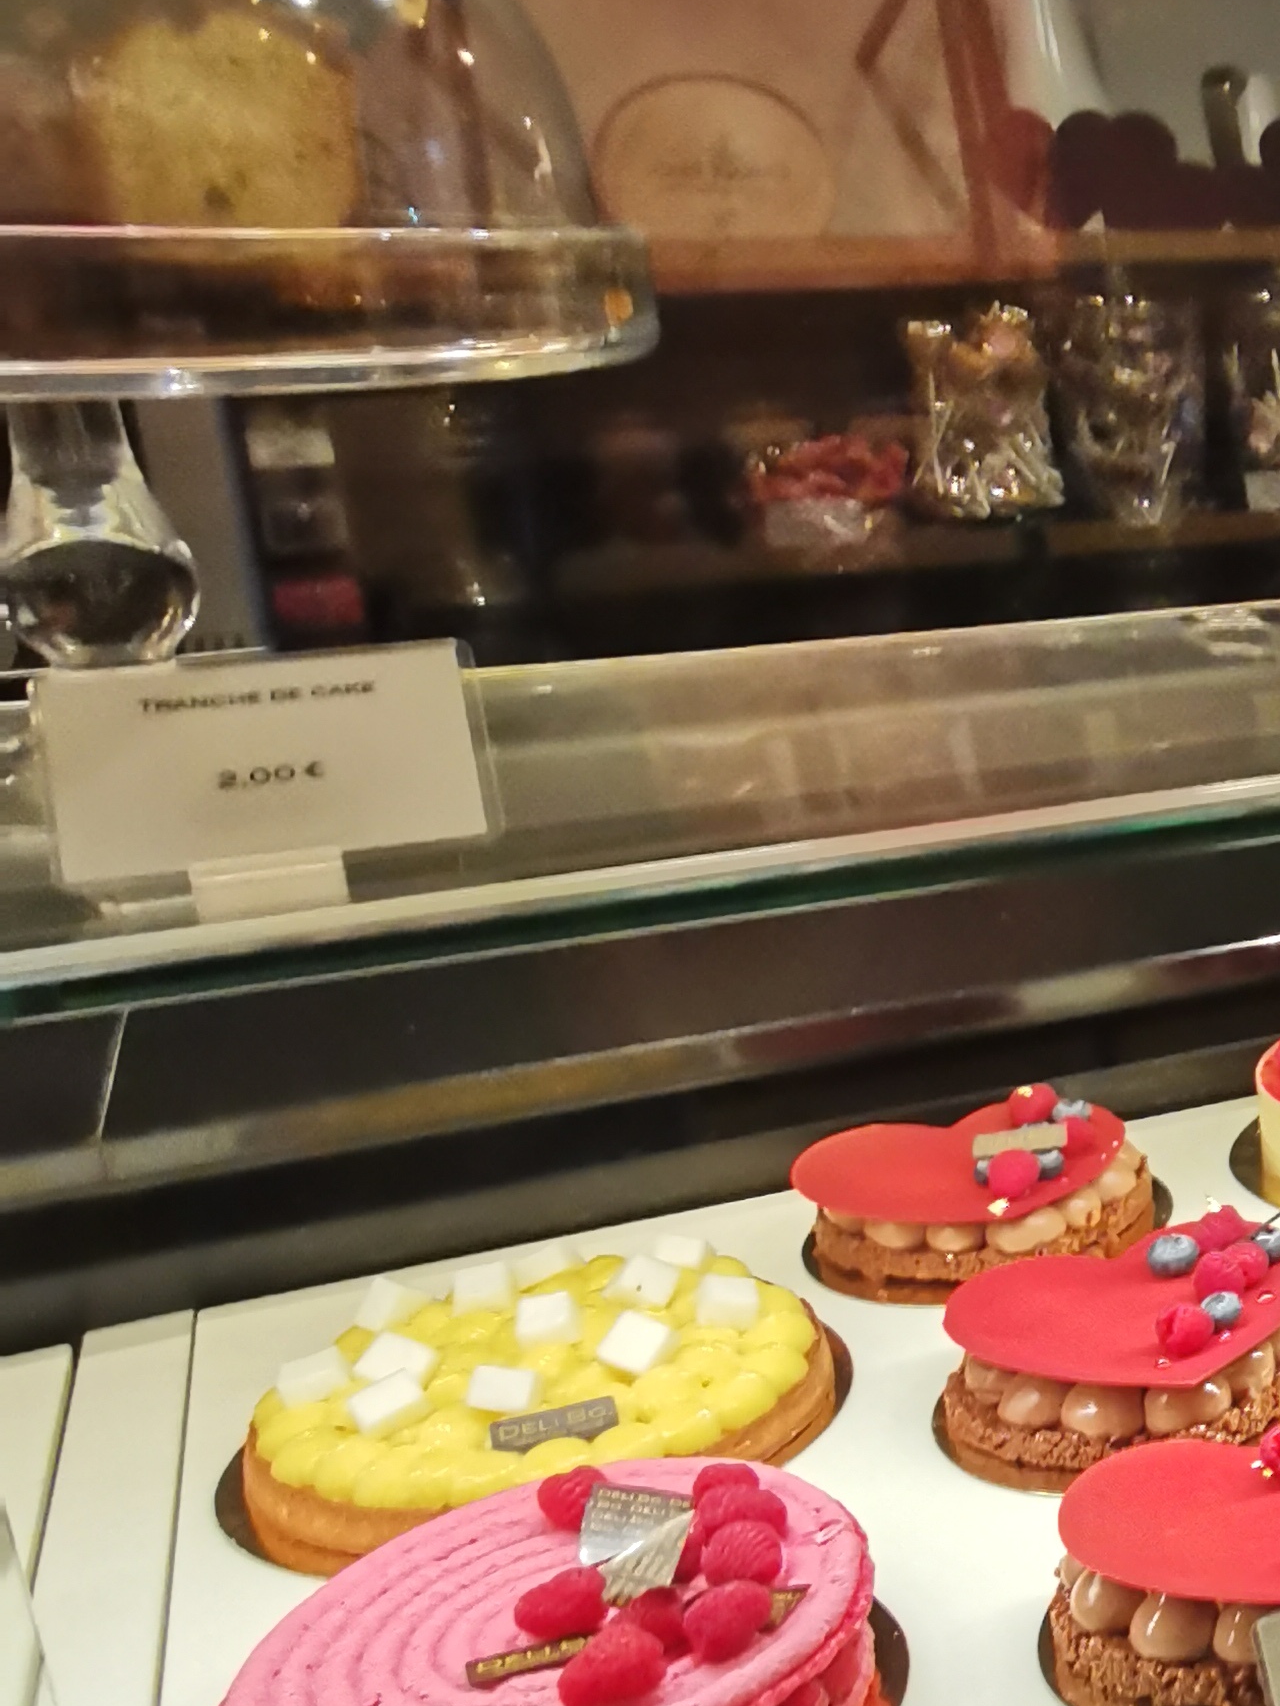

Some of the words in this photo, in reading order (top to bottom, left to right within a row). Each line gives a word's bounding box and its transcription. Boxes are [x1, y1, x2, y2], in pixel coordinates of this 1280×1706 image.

[141, 689, 261, 713] TRANCHE
[270, 685, 299, 702] DE
[311, 680, 375, 697] CAKE
[305, 760, 324, 779] €
[498, 1417, 560, 1442] DELI
